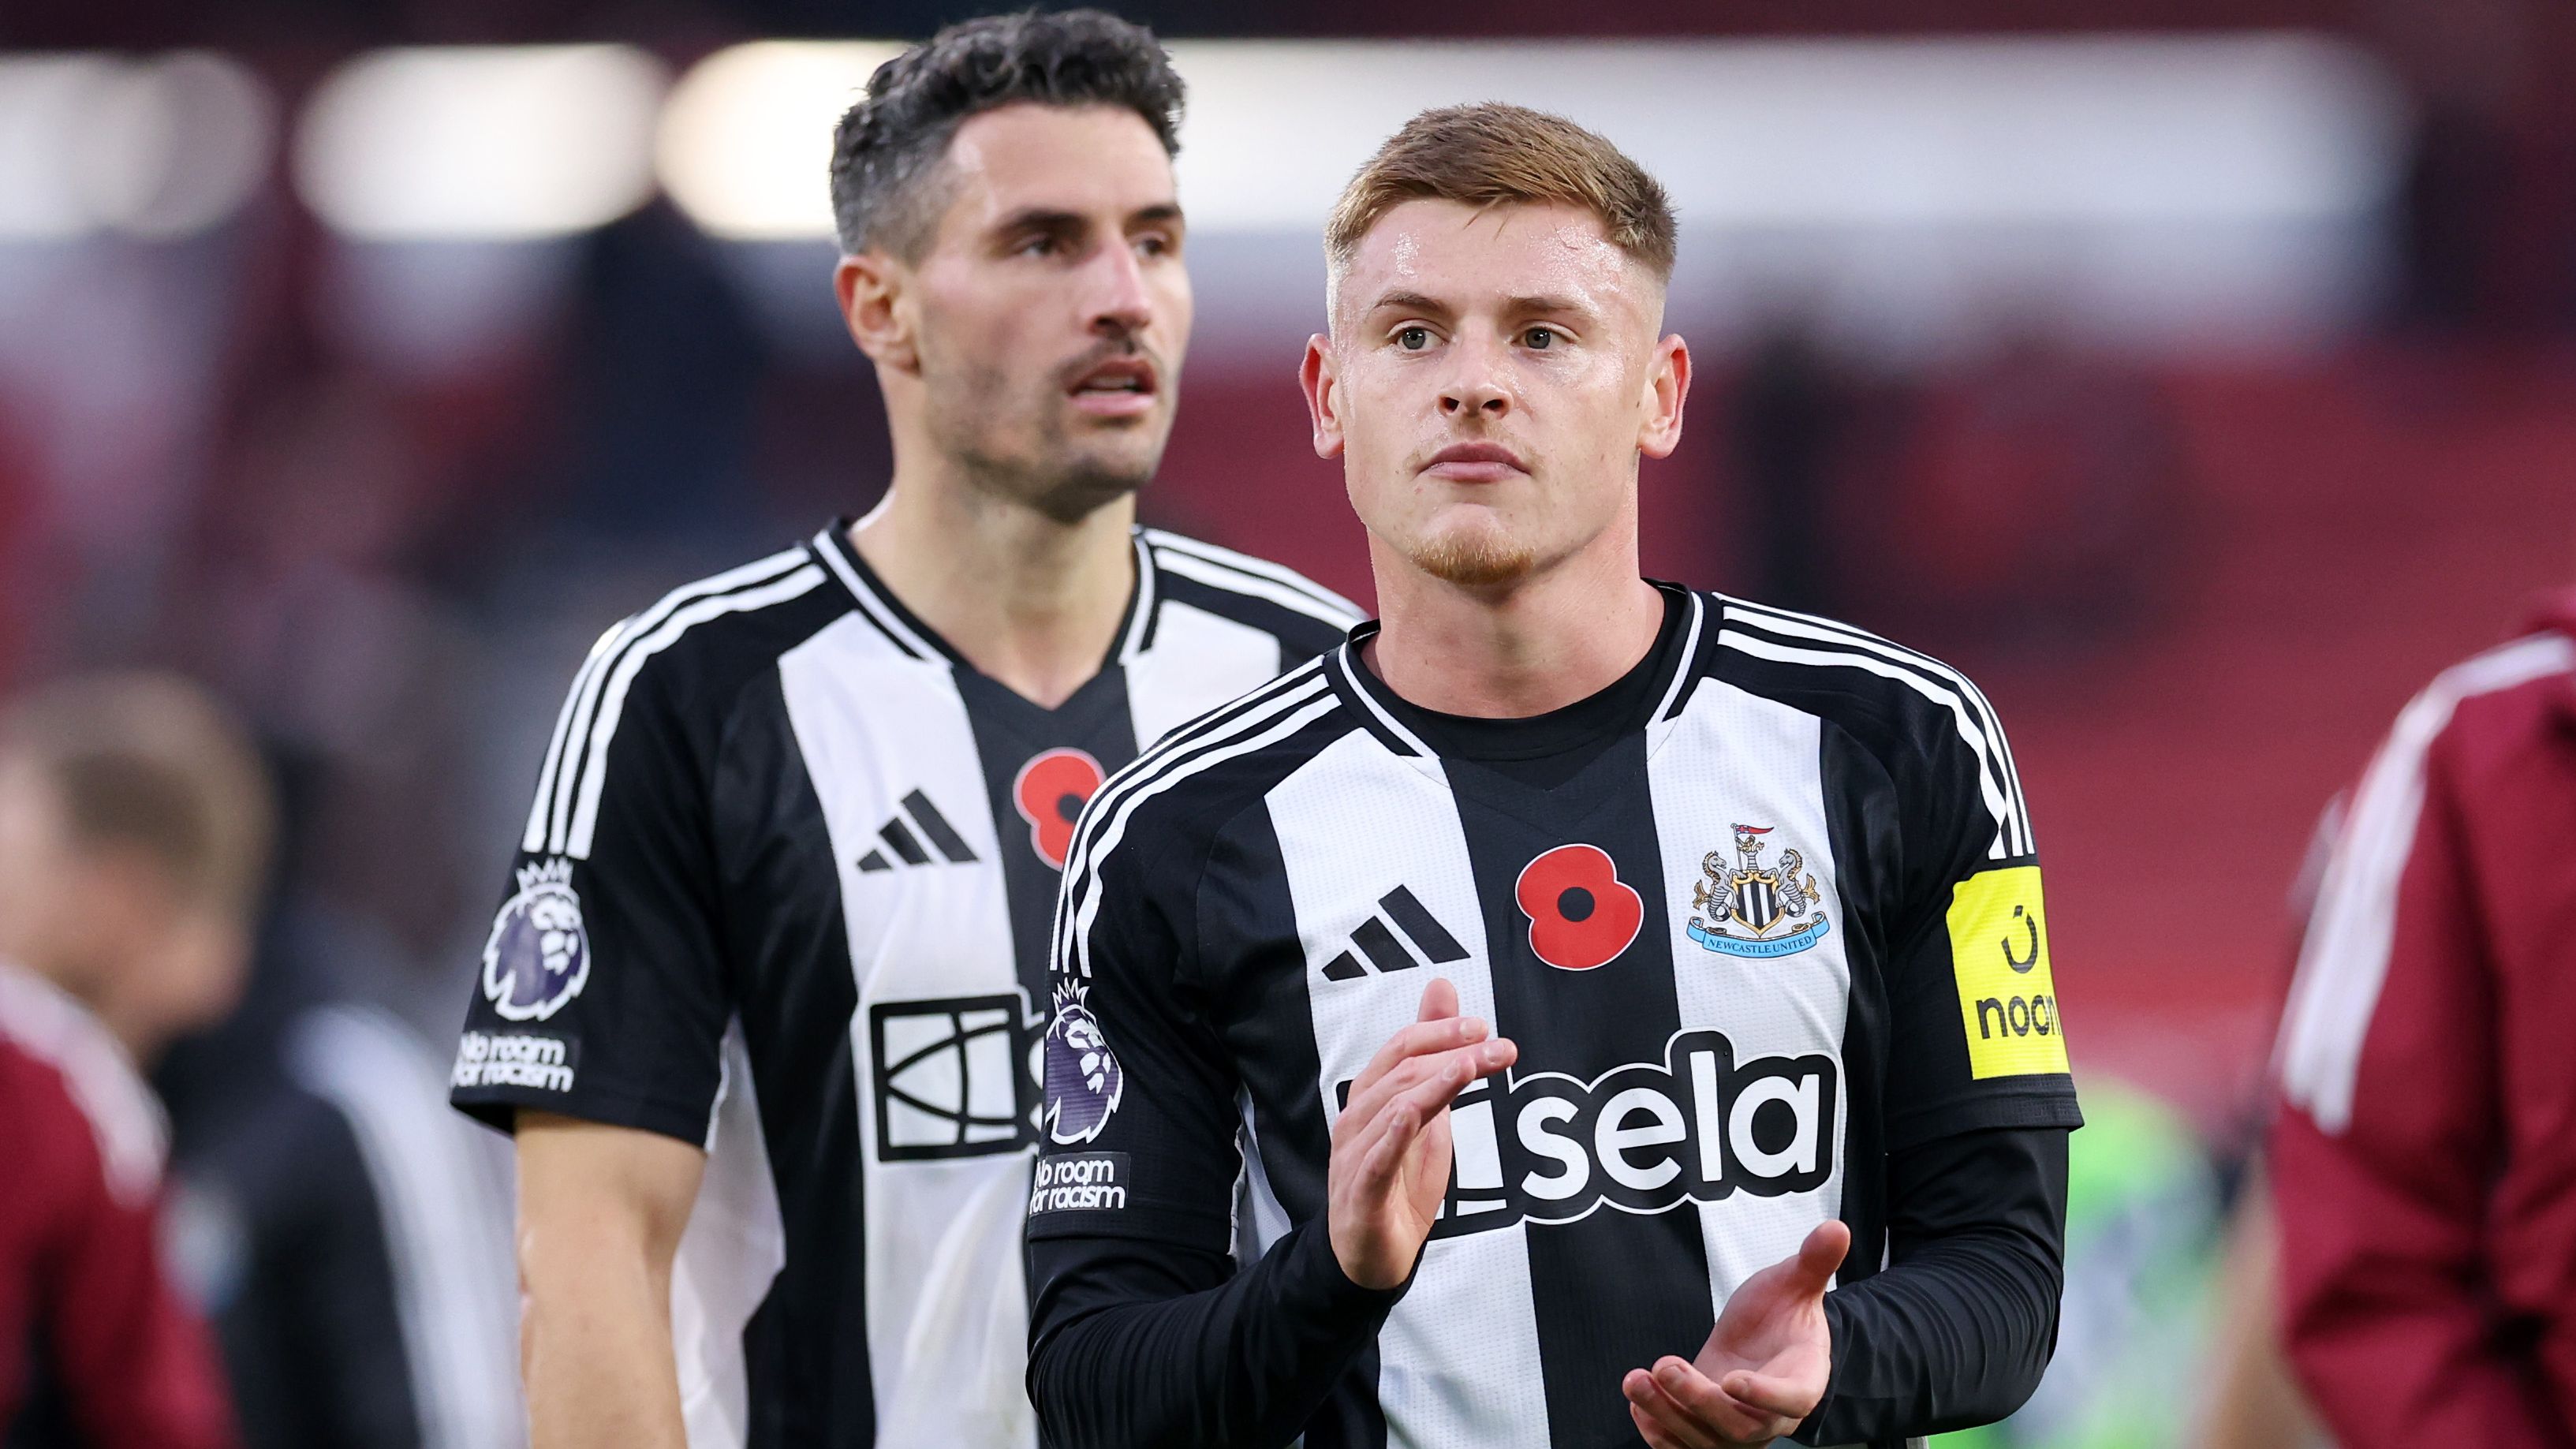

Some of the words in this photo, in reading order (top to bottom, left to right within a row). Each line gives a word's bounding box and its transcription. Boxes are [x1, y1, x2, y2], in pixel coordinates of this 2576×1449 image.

[1708, 939, 1771, 954] NEWCASTLE
[1773, 936, 1812, 951] UNITED
[490, 1035, 566, 1065] room
[482, 1061, 574, 1092] racism
[1517, 1051, 1820, 1201] sela
[1034, 1160, 1053, 1188] No
[1054, 1160, 1114, 1185] room
[1029, 1187, 1049, 1215] for
[1048, 1184, 1126, 1209] racism
